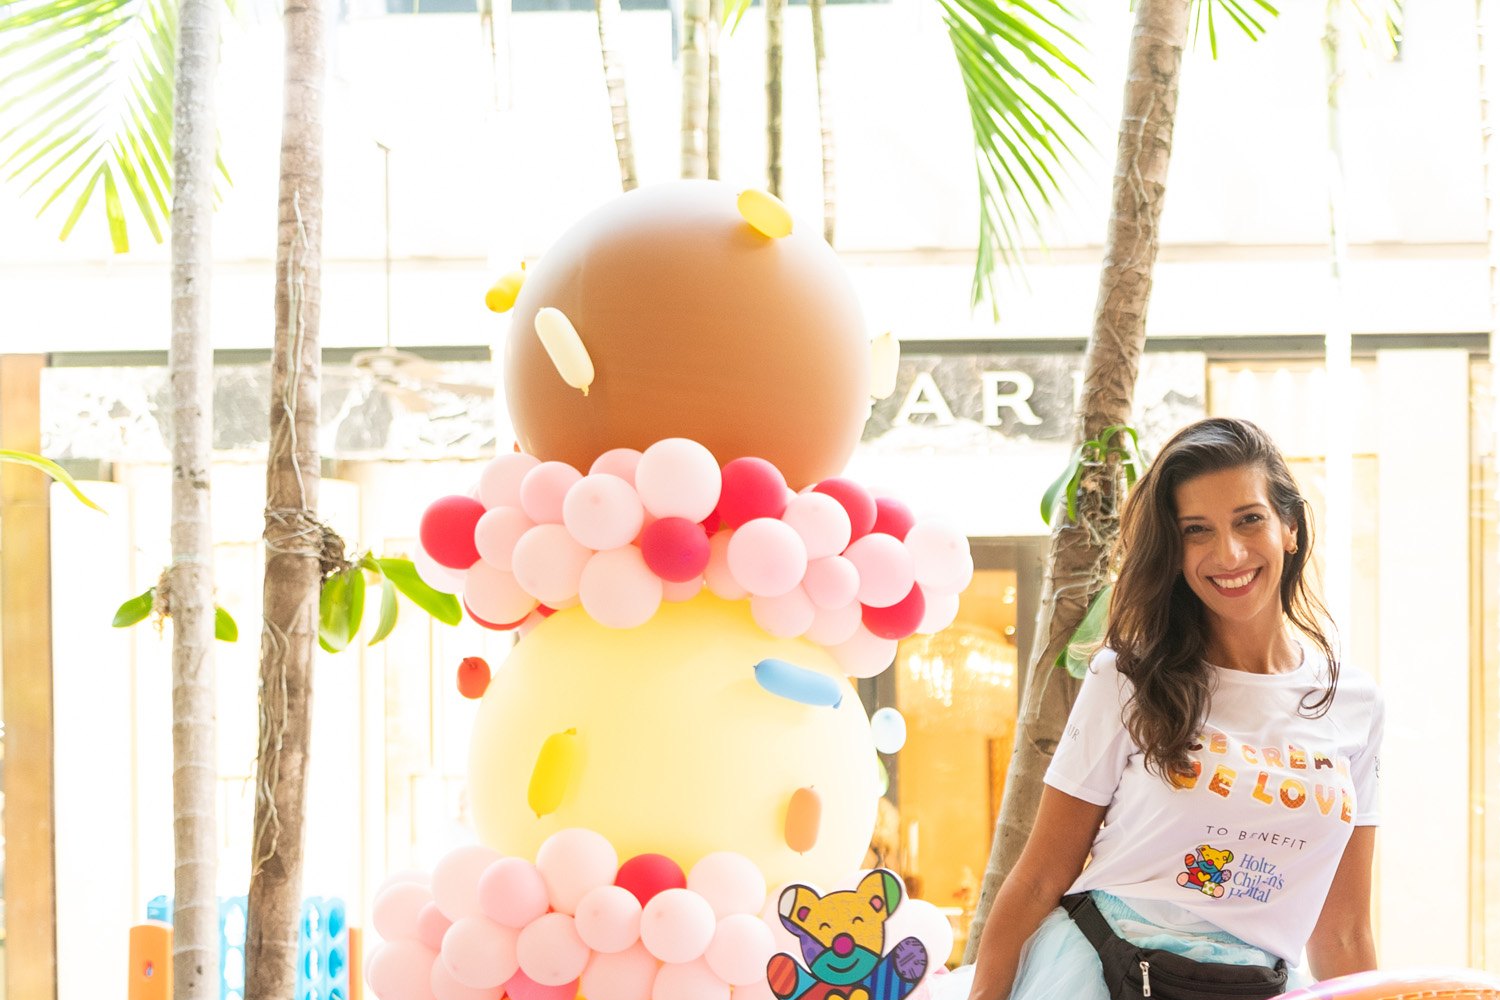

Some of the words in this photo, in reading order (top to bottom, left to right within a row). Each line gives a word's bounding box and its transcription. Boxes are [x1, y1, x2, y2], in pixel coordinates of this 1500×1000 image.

[1252, 771, 1352, 824] LOVE
[1206, 825, 1229, 836] TO
[1239, 853, 1277, 876] Holtz
